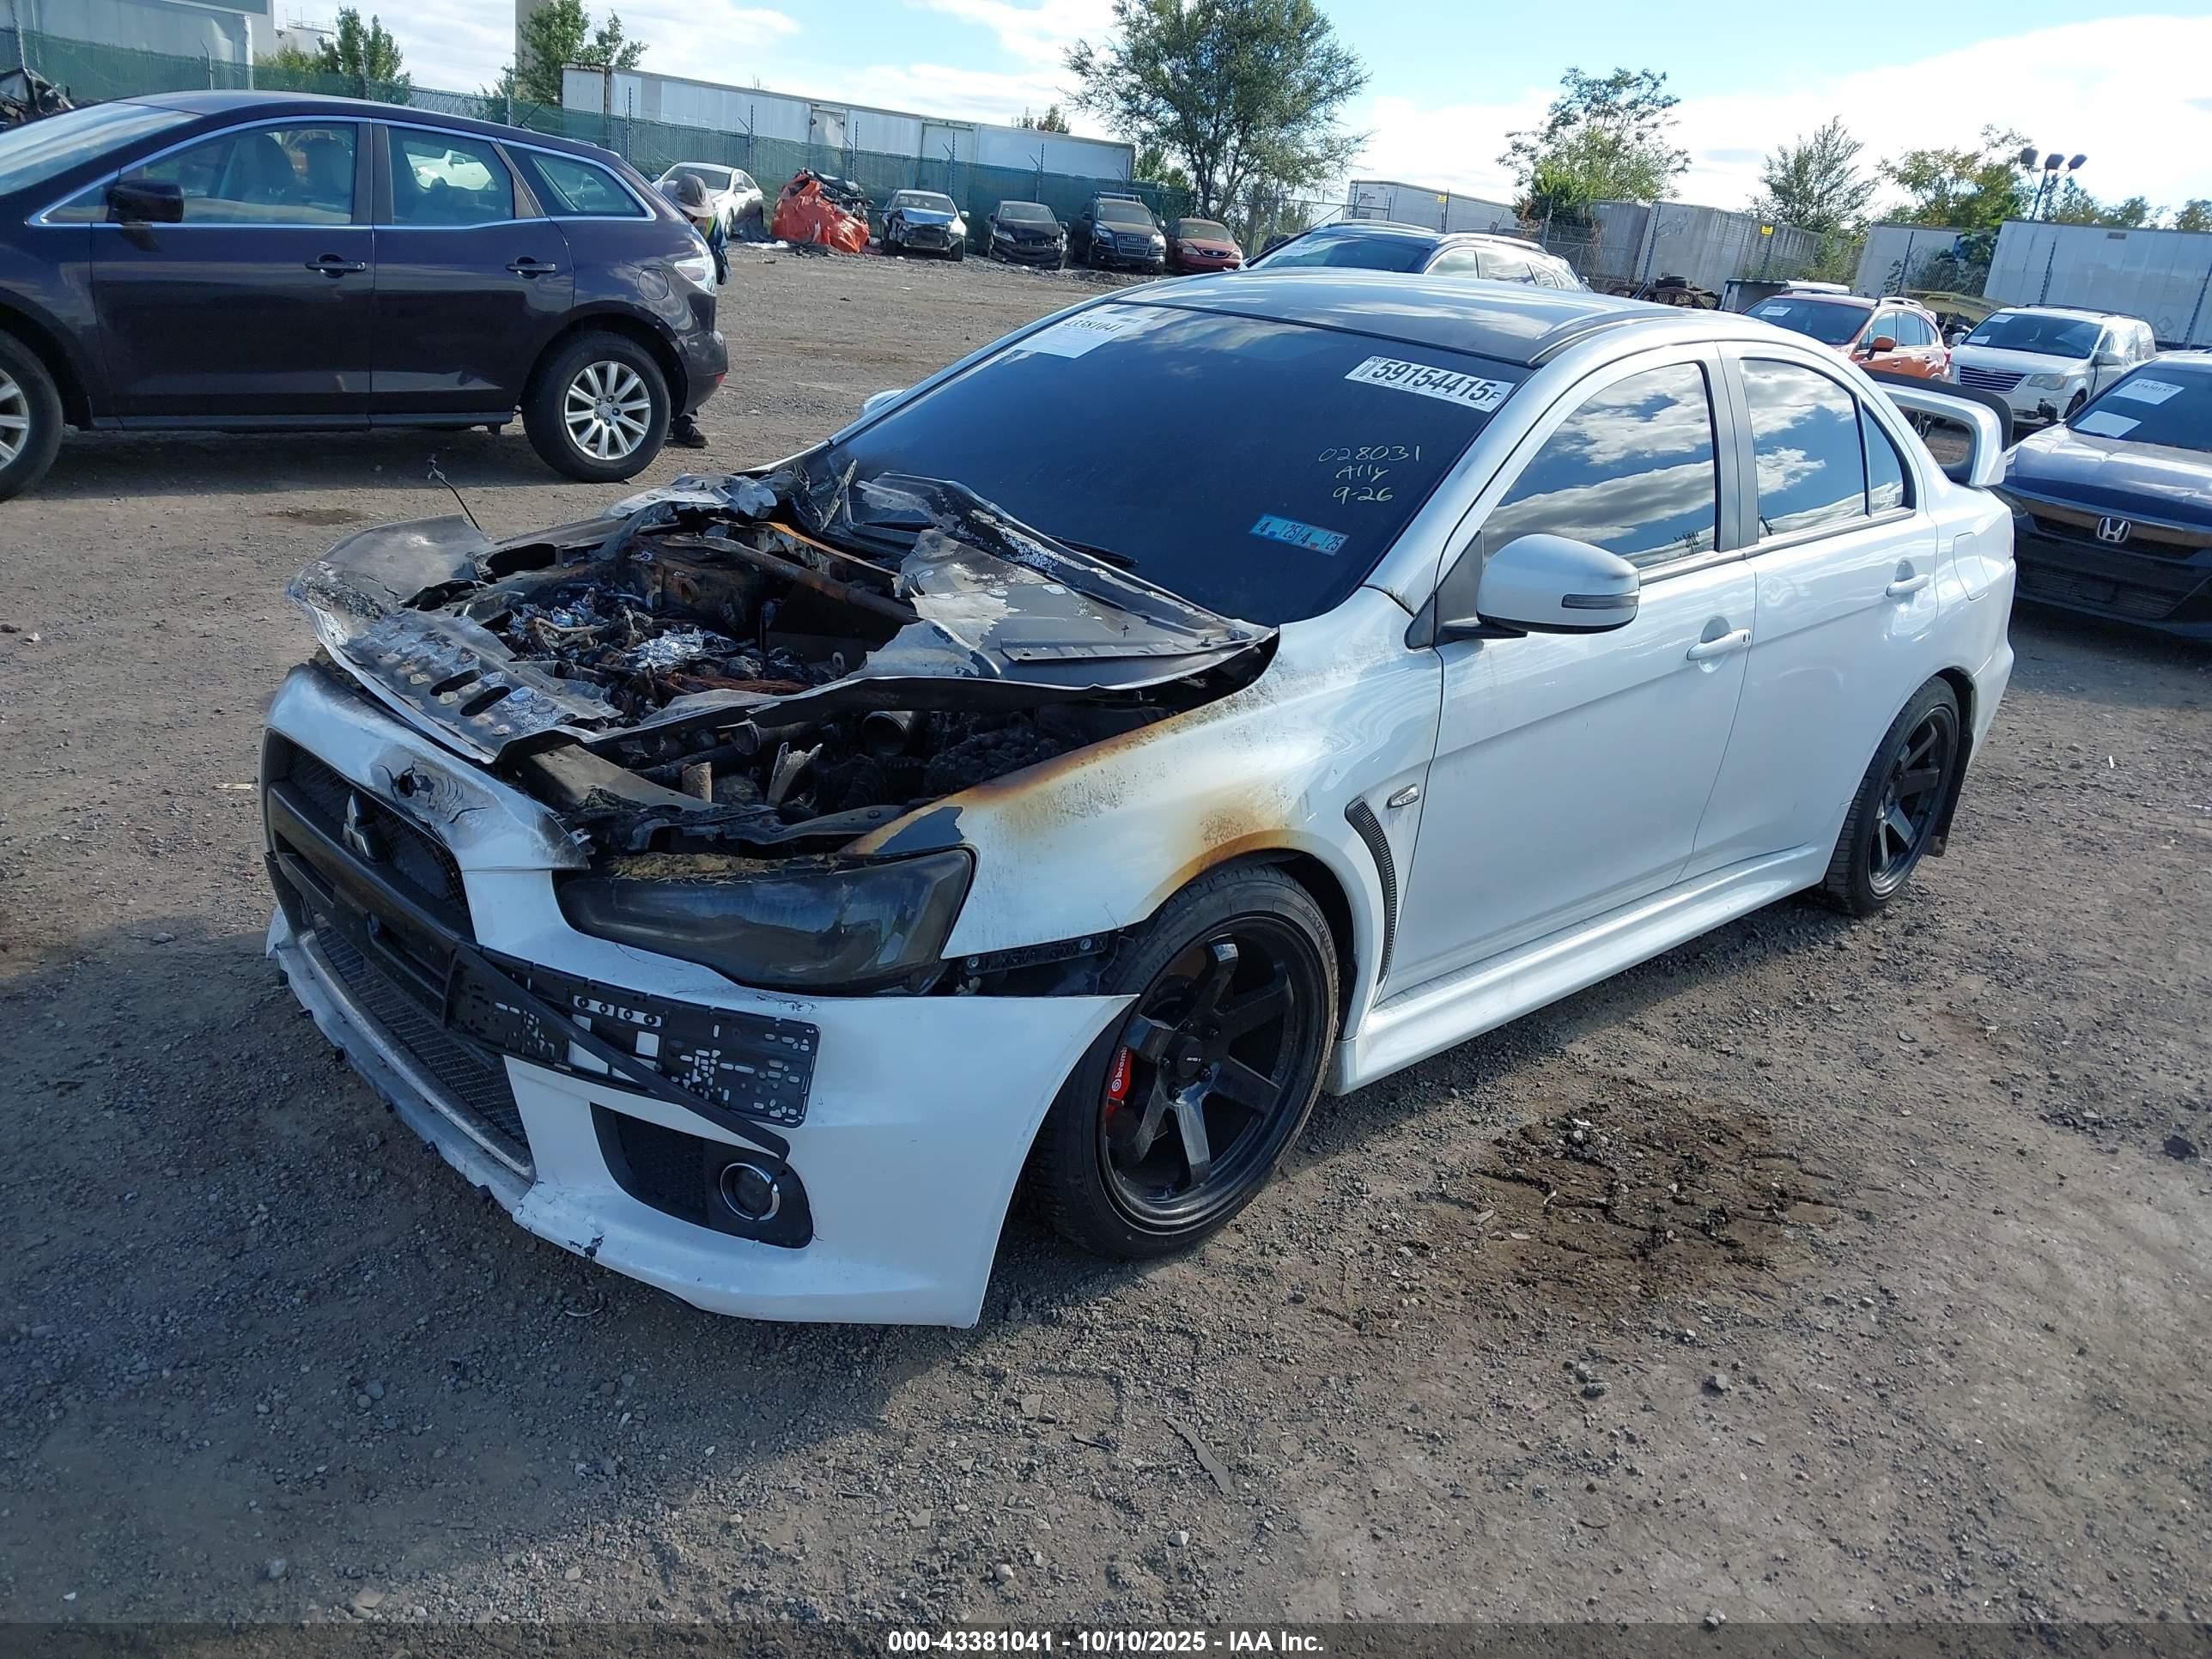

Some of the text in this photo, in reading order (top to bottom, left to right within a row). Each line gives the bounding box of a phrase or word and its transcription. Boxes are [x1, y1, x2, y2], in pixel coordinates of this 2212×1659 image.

[1370, 361, 1497, 401] 59154415
[1318, 444, 1421, 462] 028031
[1333, 486, 1394, 505] 9-26
